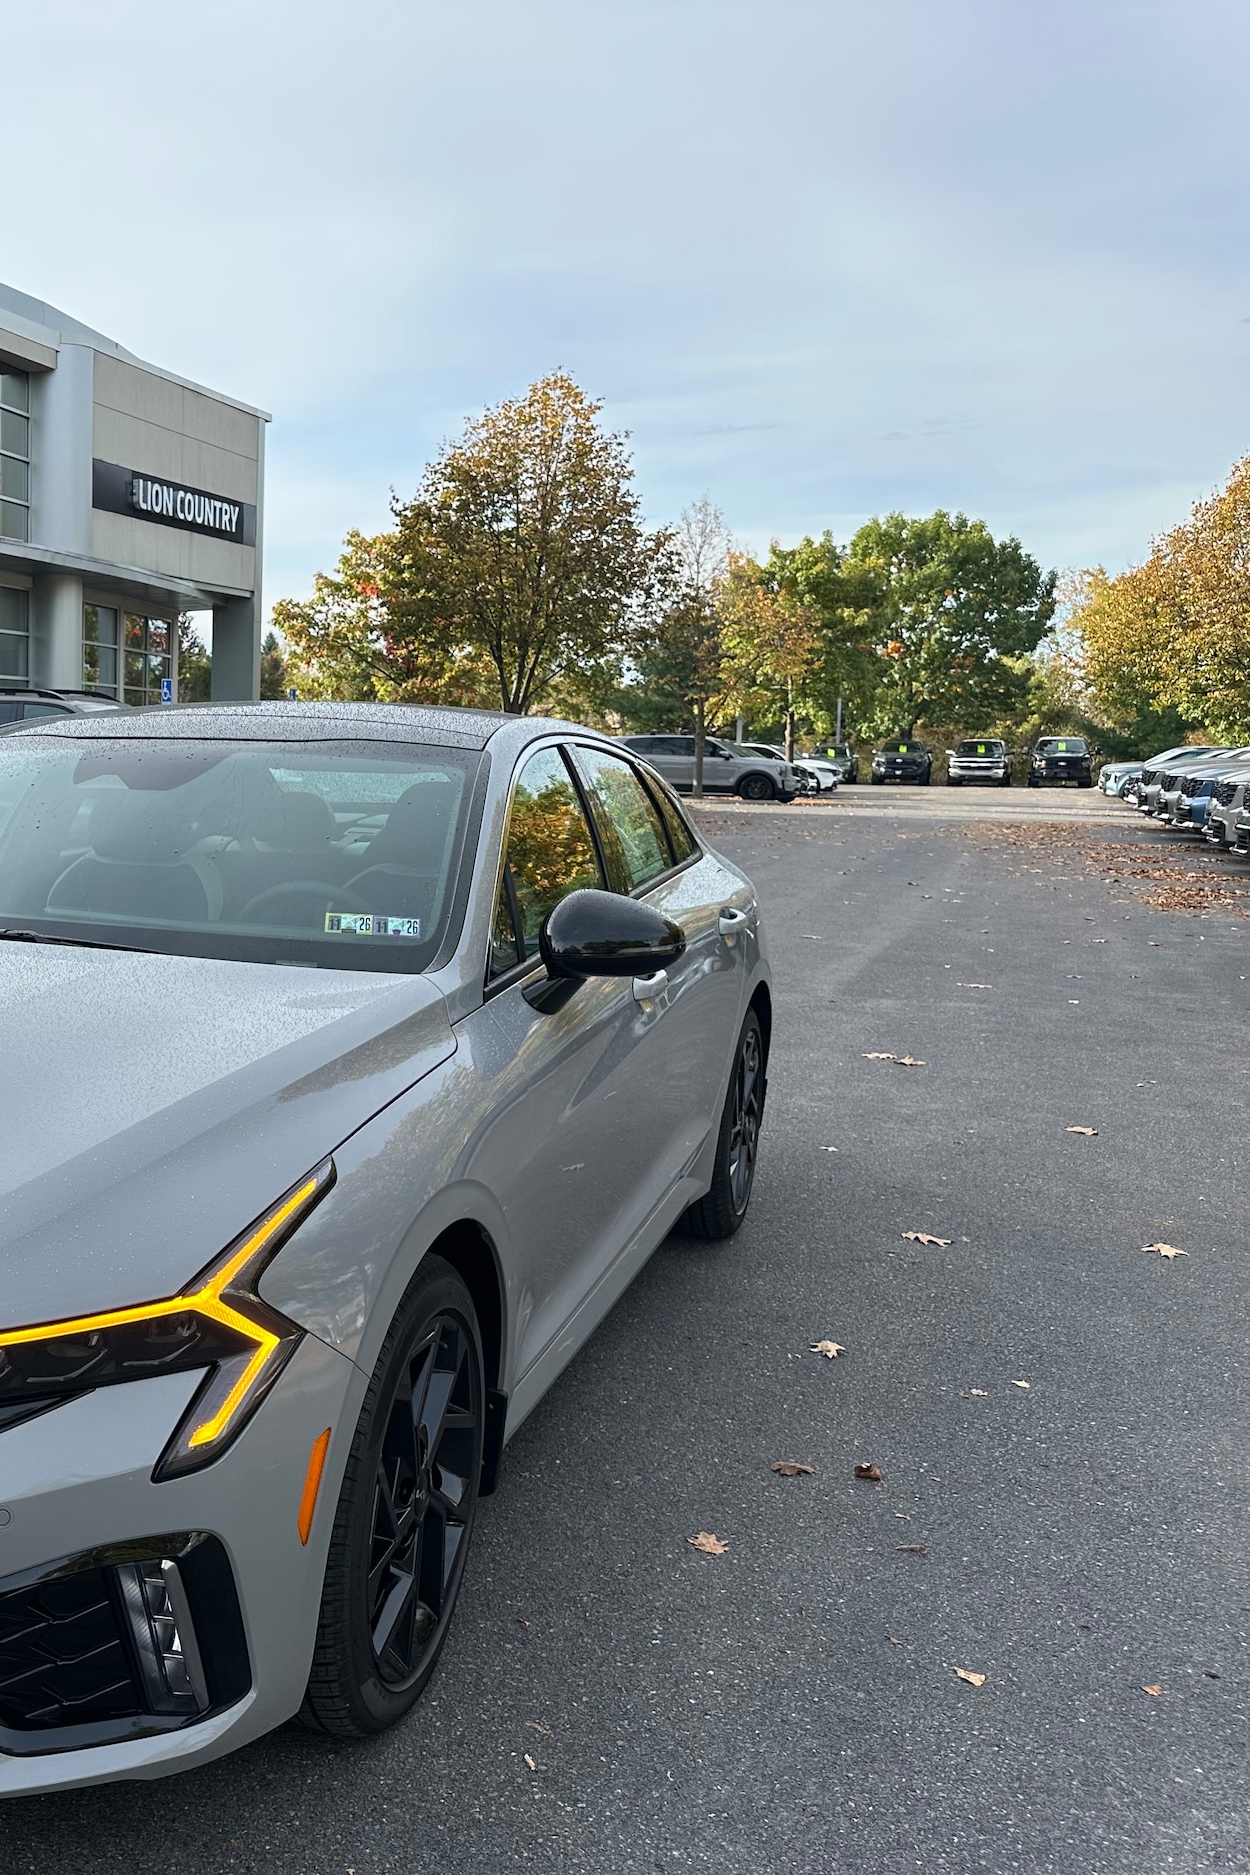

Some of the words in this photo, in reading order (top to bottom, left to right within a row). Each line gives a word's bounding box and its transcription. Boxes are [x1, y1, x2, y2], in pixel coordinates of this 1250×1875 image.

[134, 479, 173, 517] LION
[176, 490, 239, 533] COUNTRY
[359, 917, 371, 931] 26
[406, 920, 418, 934] 26
